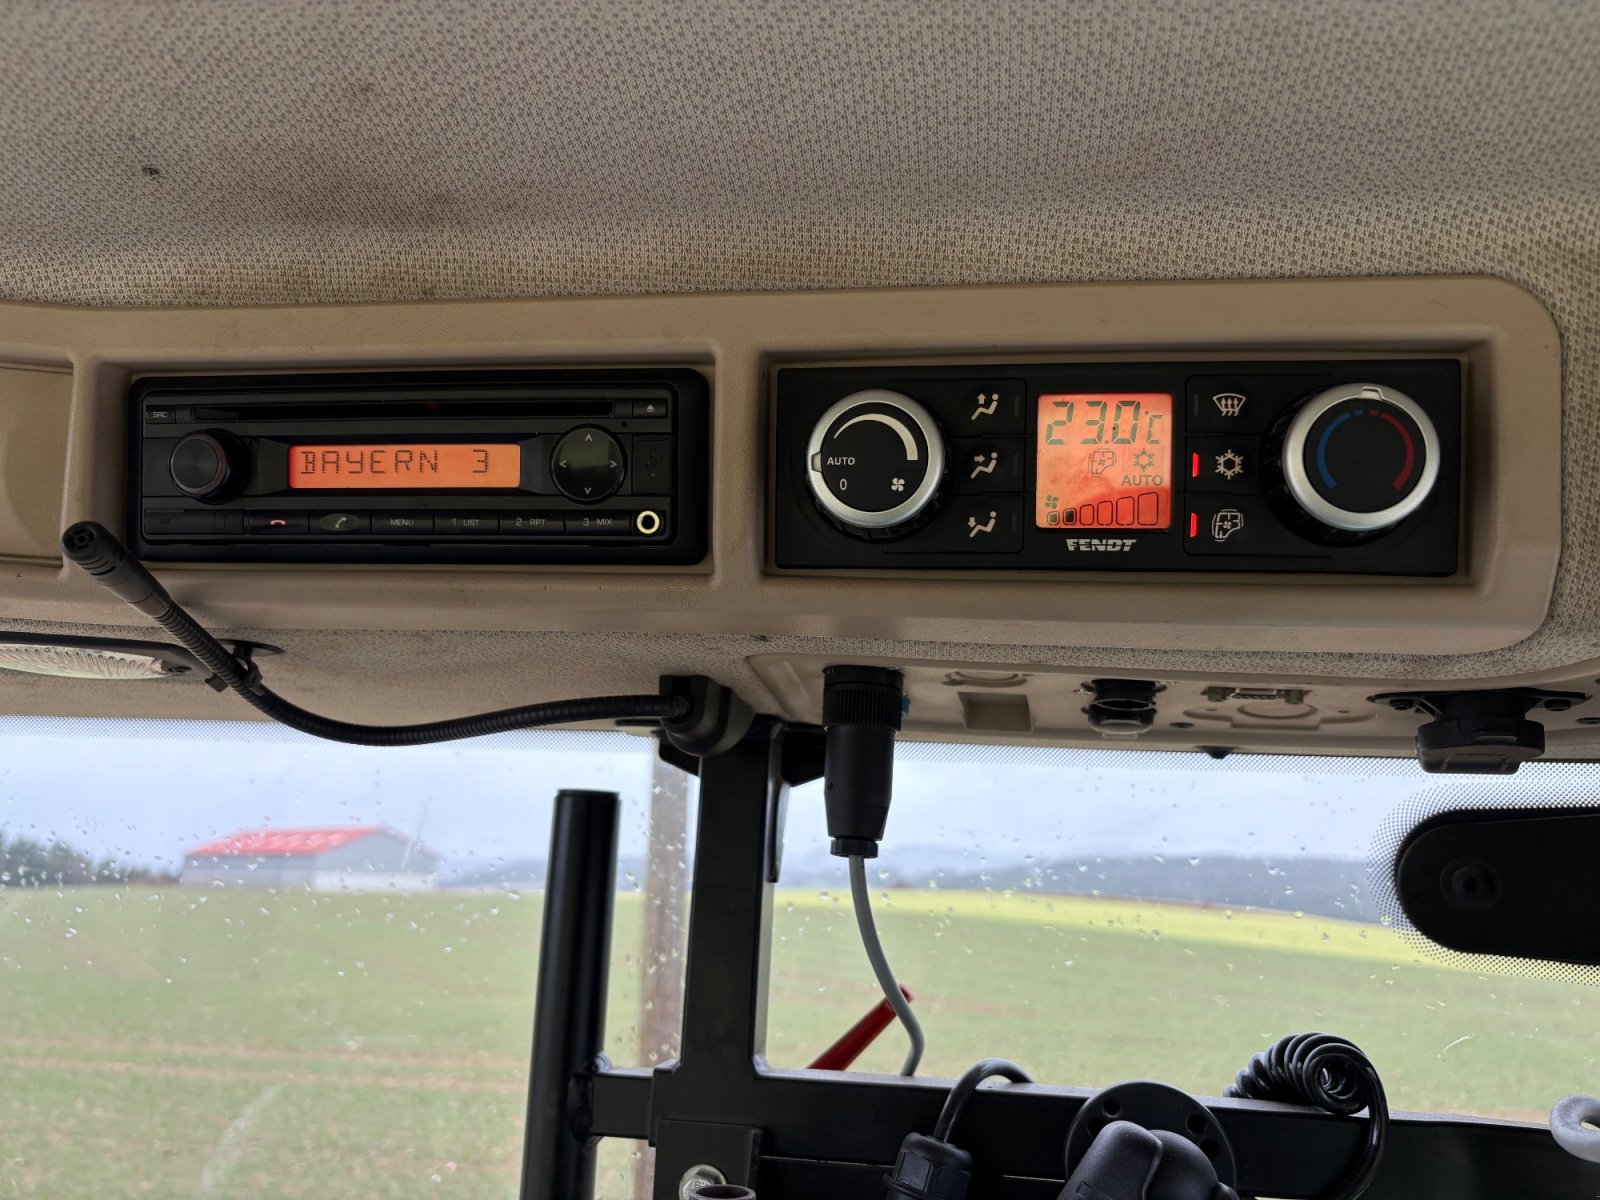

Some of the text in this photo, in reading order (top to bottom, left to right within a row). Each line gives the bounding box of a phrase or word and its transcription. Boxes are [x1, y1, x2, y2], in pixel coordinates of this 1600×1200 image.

[152, 411, 168, 419] SRC
[300, 449, 489, 474] BAYERN 3
[826, 457, 856, 466] AUTO
[1121, 475, 1164, 486] AUTO
[390, 518, 414, 526] MENU
[451, 517, 480, 526] 1 LIST
[516, 517, 547, 527] 2 RPT
[583, 517, 613, 527] 3 MIX
[1065, 538, 1137, 551] FENDT
